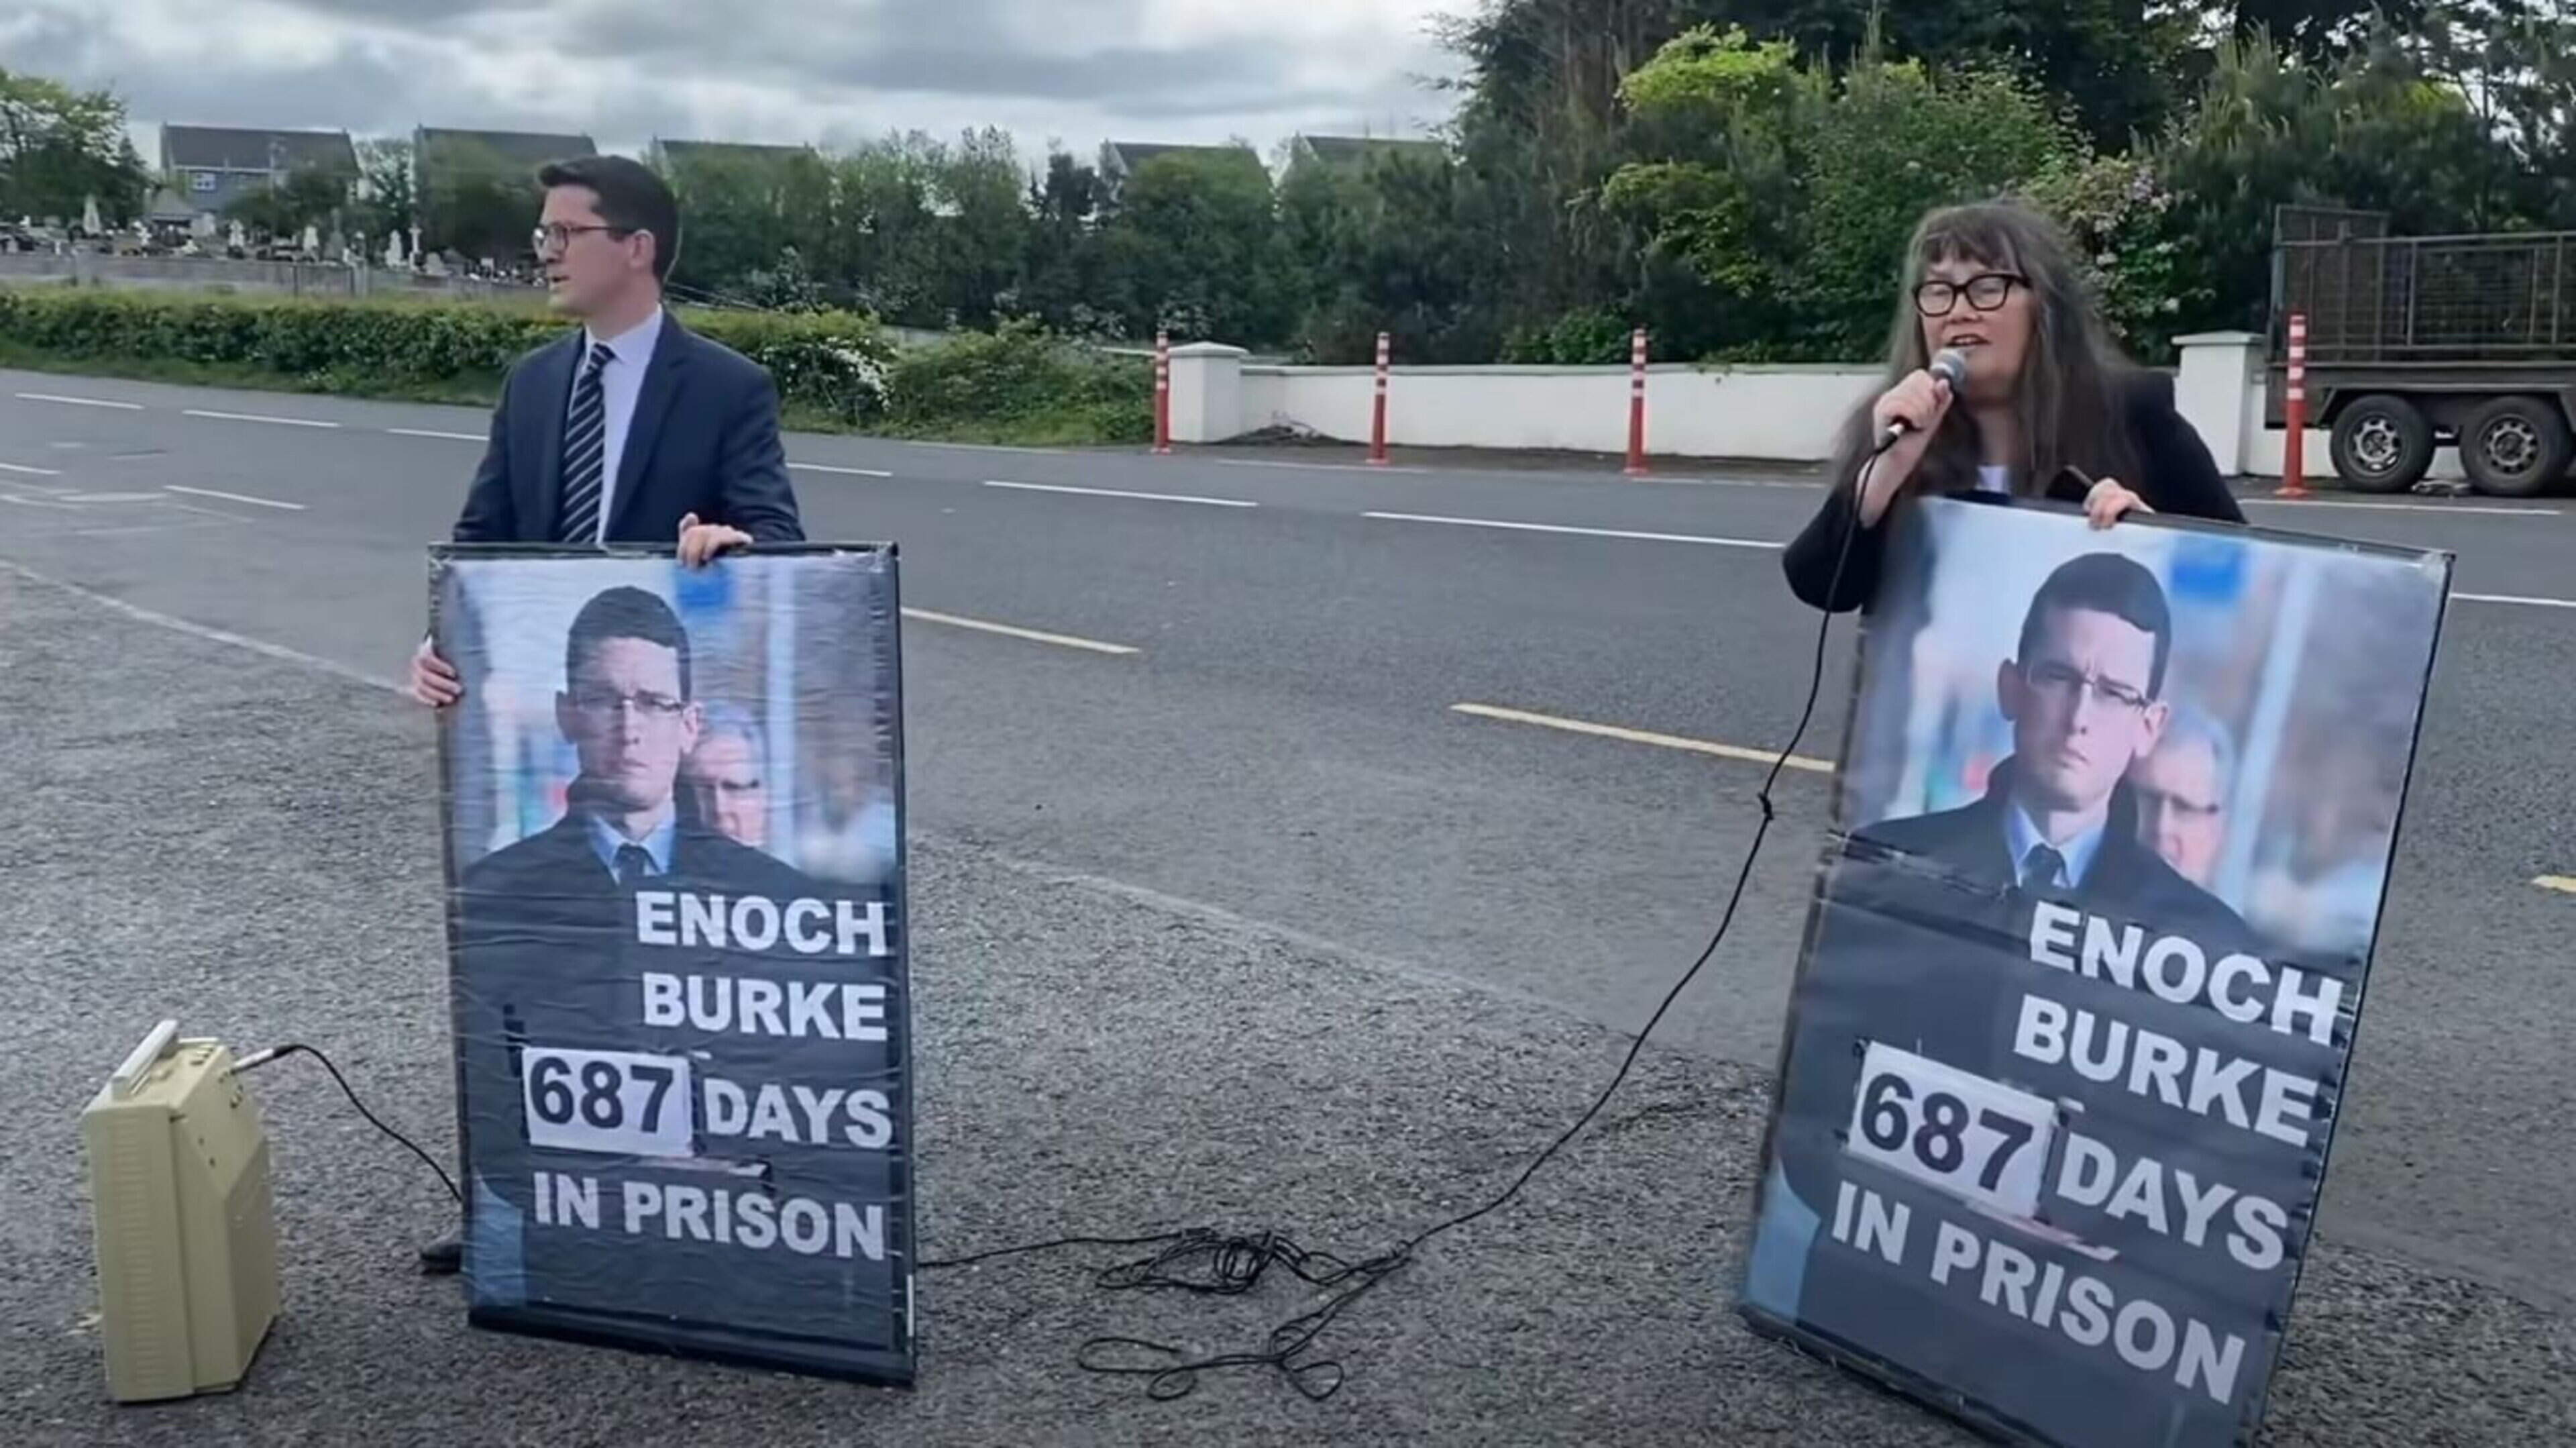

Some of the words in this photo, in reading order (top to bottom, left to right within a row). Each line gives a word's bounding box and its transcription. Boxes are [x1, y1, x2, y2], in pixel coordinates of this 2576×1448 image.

[635, 892, 888, 956] ENOCH
[2029, 900, 2343, 1046] ENOCH
[642, 972, 888, 1041] BURKE
[530, 1057, 674, 1135] 687
[703, 1078, 893, 1149] DAYS
[2013, 994, 2320, 1147] BURKE
[533, 1172, 600, 1229] IN
[623, 1181, 884, 1261] PRISON
[1860, 1072, 2034, 1192] 687
[2056, 1133, 2289, 1271] DAYS
[1831, 1180, 1911, 1265] IN
[1930, 1225, 2246, 1405] PRISON
